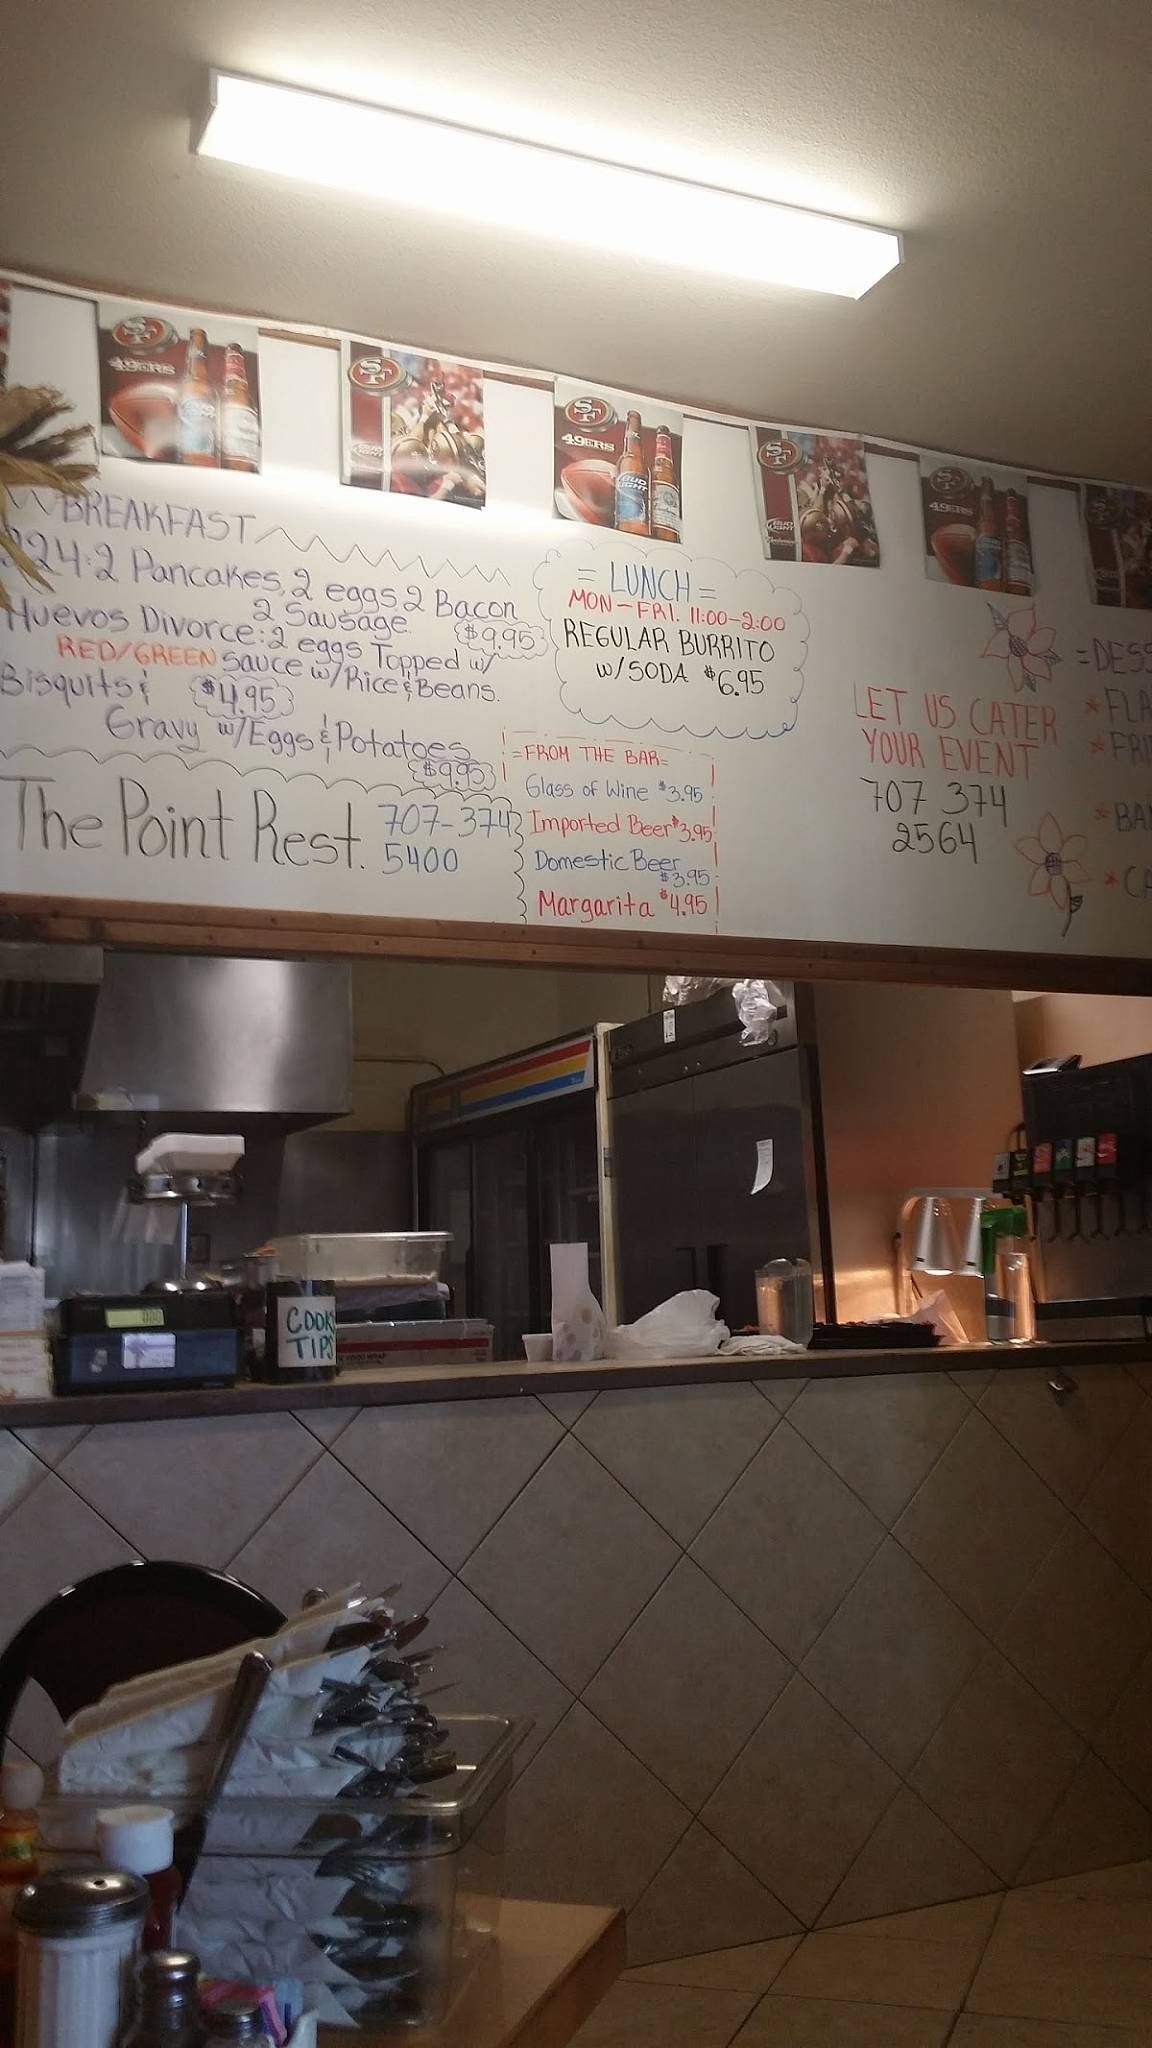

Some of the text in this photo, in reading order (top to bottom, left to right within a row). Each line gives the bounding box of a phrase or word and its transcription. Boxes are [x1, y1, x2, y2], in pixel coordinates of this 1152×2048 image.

[108, 356, 176, 374] 49ERS
[562, 433, 615, 452] 49ERS
[63, 491, 256, 544] BREAKFAST
[929, 501, 974, 517] 49ERS
[133, 548, 286, 596] Pancakes,
[292, 568, 313, 601] 2
[403, 585, 425, 611] 2
[436, 589, 518, 620] Bacon
[609, 561, 691, 603] LUNCH
[253, 598, 274, 621] 2
[7, 598, 129, 632] Huevos
[298, 638, 362, 665] eggs
[370, 642, 459, 677] Topped
[469, 652, 497, 675] w/
[465, 624, 535, 650] $9.95
[564, 618, 775, 663] REGULAR BURRITO
[57, 633, 217, 666] RED/GREEN
[222, 652, 303, 678] sauce
[0, 661, 133, 709] Bisquits
[597, 656, 765, 697] w/SODA $6.95
[201, 680, 276, 715] $4.95
[854, 681, 1058, 745] LET US CATER
[106, 704, 206, 753] Gravy
[335, 721, 472, 761] Potatoes
[579, 746, 615, 763] THE
[861, 728, 1040, 781] YOUR EVENT
[423, 761, 486, 787] $9.95
[526, 773, 703, 803] Glass of Wine $3.95
[859, 777, 1008, 827] 707 374
[1114, 803, 1152, 832] BA
[0, 775, 103, 851] The
[120, 776, 235, 861] Point
[254, 789, 366, 869] Rest.
[527, 809, 713, 843] Imported Beer $3.95
[382, 842, 459, 875] 5400
[535, 848, 682, 872] Domestic Beer
[892, 822, 978, 864] 2564
[661, 869, 711, 889] $3.95
[538, 888, 708, 923] Margarita $4.95
